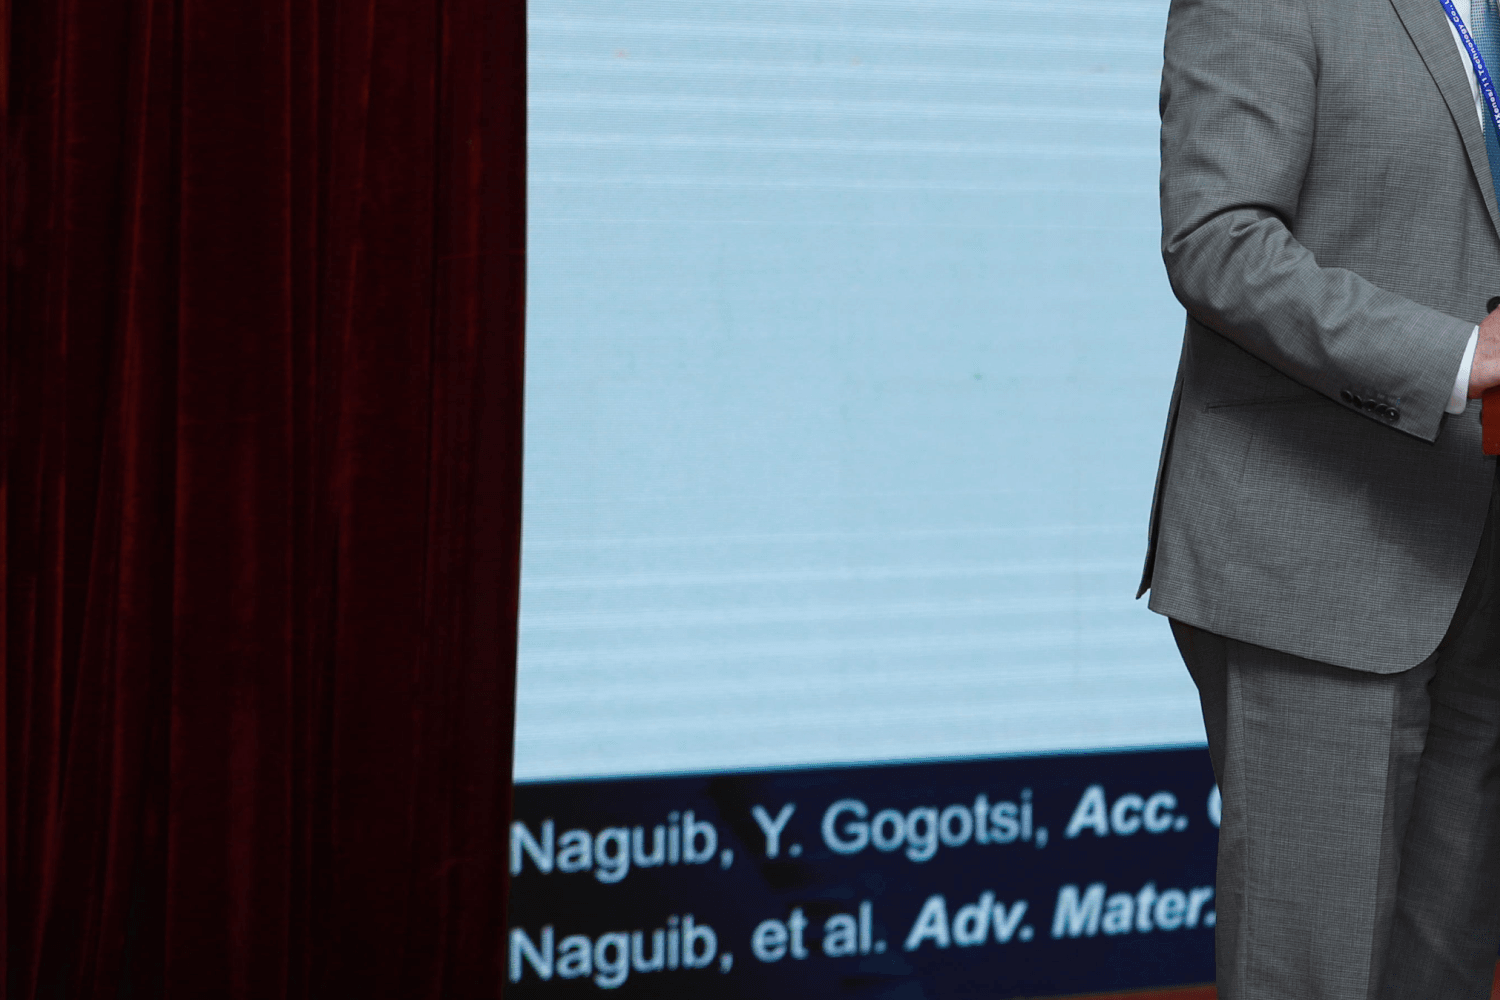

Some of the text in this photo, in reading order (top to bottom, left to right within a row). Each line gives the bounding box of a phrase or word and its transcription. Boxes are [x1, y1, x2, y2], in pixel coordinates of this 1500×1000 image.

[1458, 24, 1485, 77] Technology
[509, 809, 734, 884] Naguib,
[752, 802, 802, 859] Y.
[821, 787, 1049, 862] Gogotsi,
[1064, 783, 1188, 839] Acc.
[508, 913, 734, 990] Naguib,
[752, 907, 808, 963] et
[822, 900, 887, 958] al.
[904, 890, 1034, 950] Adv.
[1051, 880, 1216, 940] Mater.
